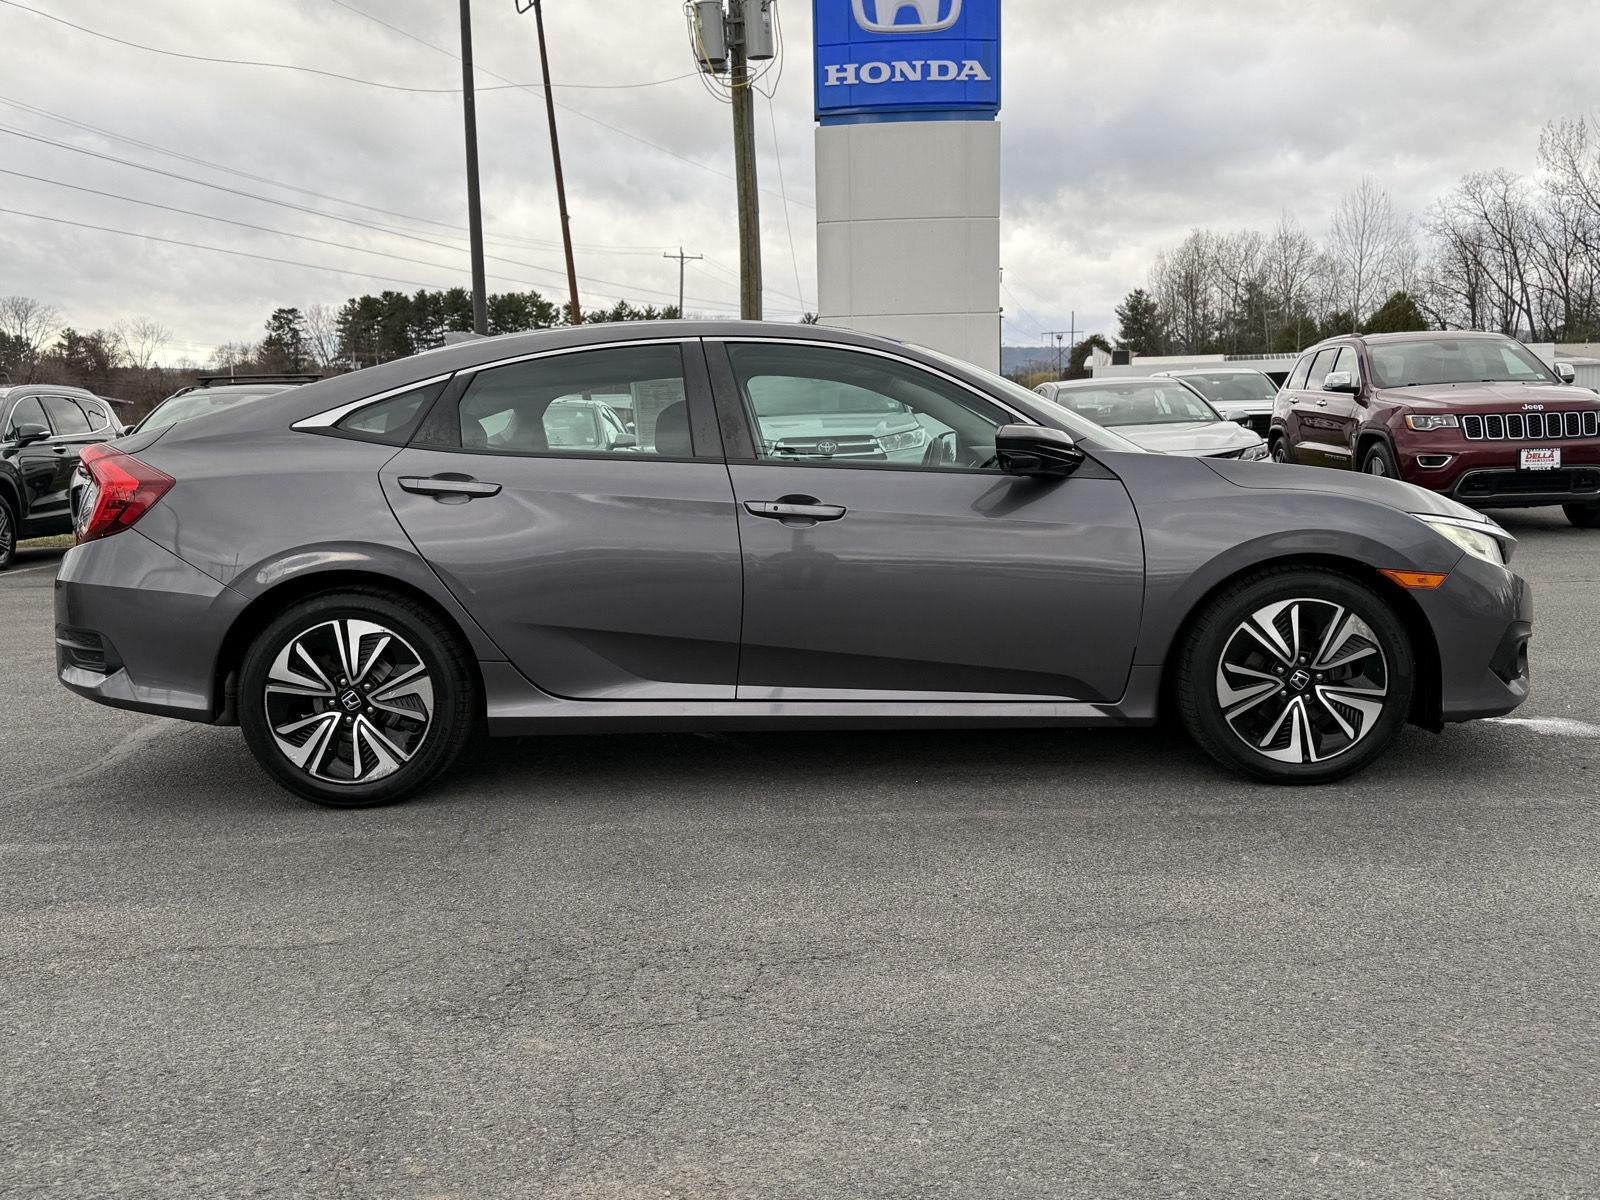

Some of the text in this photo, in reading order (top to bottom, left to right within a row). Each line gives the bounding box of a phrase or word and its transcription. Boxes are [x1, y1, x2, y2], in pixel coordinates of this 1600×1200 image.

[824, 60, 991, 86] HONDA
[1521, 403, 1544, 411] Jeep
[1525, 452, 1555, 460] DELLA
